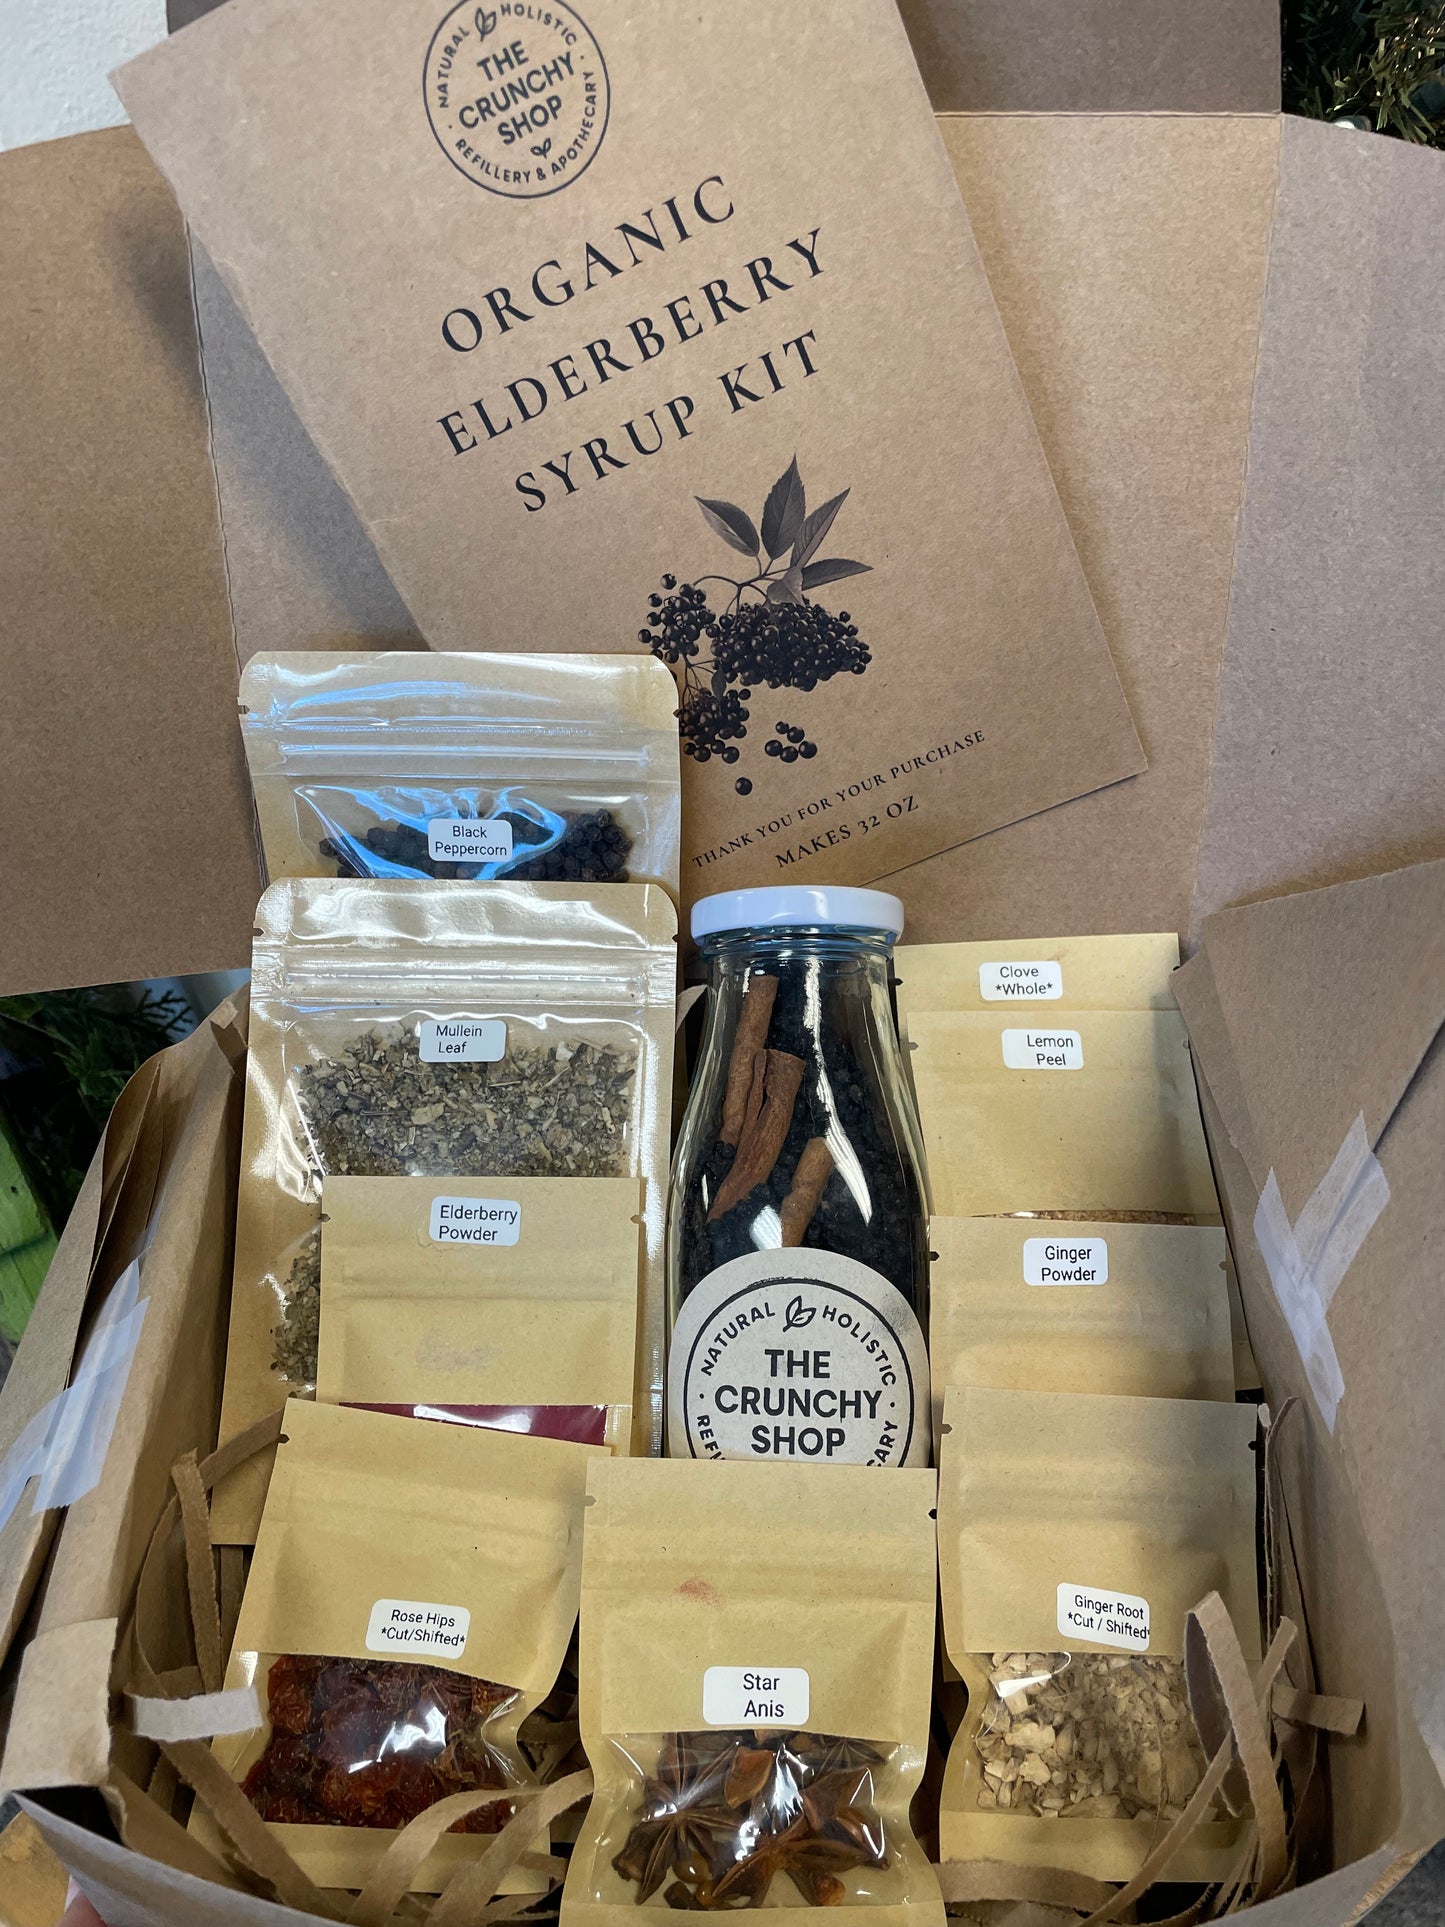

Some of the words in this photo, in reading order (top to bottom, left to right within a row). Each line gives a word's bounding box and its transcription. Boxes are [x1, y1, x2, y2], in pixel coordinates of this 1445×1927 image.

[437, 26, 470, 109] NATURAL
[500, 3, 577, 46] HOLISTIC
[477, 40, 529, 81] THE
[458, 52, 574, 129] CRUNCHY
[455, 138, 531, 183] REFILLERY
[536, 167, 546, 181] &
[551, 71, 597, 175] APOTHECARY
[497, 95, 562, 145] SHOP
[441, 175, 735, 352] ORGANIC
[436, 228, 824, 456] ELDERBERRY
[515, 395, 695, 512] SYRUP
[717, 329, 819, 414] KIT
[692, 832, 754, 868] THANK
[755, 814, 793, 838] YOU
[797, 798, 833, 820] FOR
[835, 774, 886, 802] YOUR
[889, 730, 986, 779] PURCHASE
[452, 825, 487, 838] Black
[775, 824, 851, 868] MAKES
[857, 815, 881, 835] 32
[886, 795, 919, 819] OZ
[435, 841, 507, 857] Peppercorn
[999, 966, 1039, 978] Clove
[436, 1025, 482, 1037] Mullein
[1027, 1034, 1074, 1048] Lemon
[438, 1041, 467, 1053] Leaf
[1036, 1053, 1067, 1066] Peel
[440, 1204, 518, 1225] Elderberry
[439, 1225, 498, 1241] Powder
[1045, 1245, 1092, 1264] Ginger
[1041, 1267, 1096, 1282] Powder
[701, 1302, 775, 1376] NATURAL
[822, 1305, 897, 1386] HOLISTIC
[764, 1348, 831, 1379] THE
[714, 1384, 882, 1420] CRUNCHY
[751, 1424, 846, 1457] SHOP
[391, 1609, 423, 1623] Rose
[426, 1612, 456, 1628] Hips
[1074, 1594, 1113, 1615] Ginger
[1117, 1602, 1144, 1620] Root
[743, 1673, 780, 1690] Star
[743, 1699, 785, 1718] Anis
